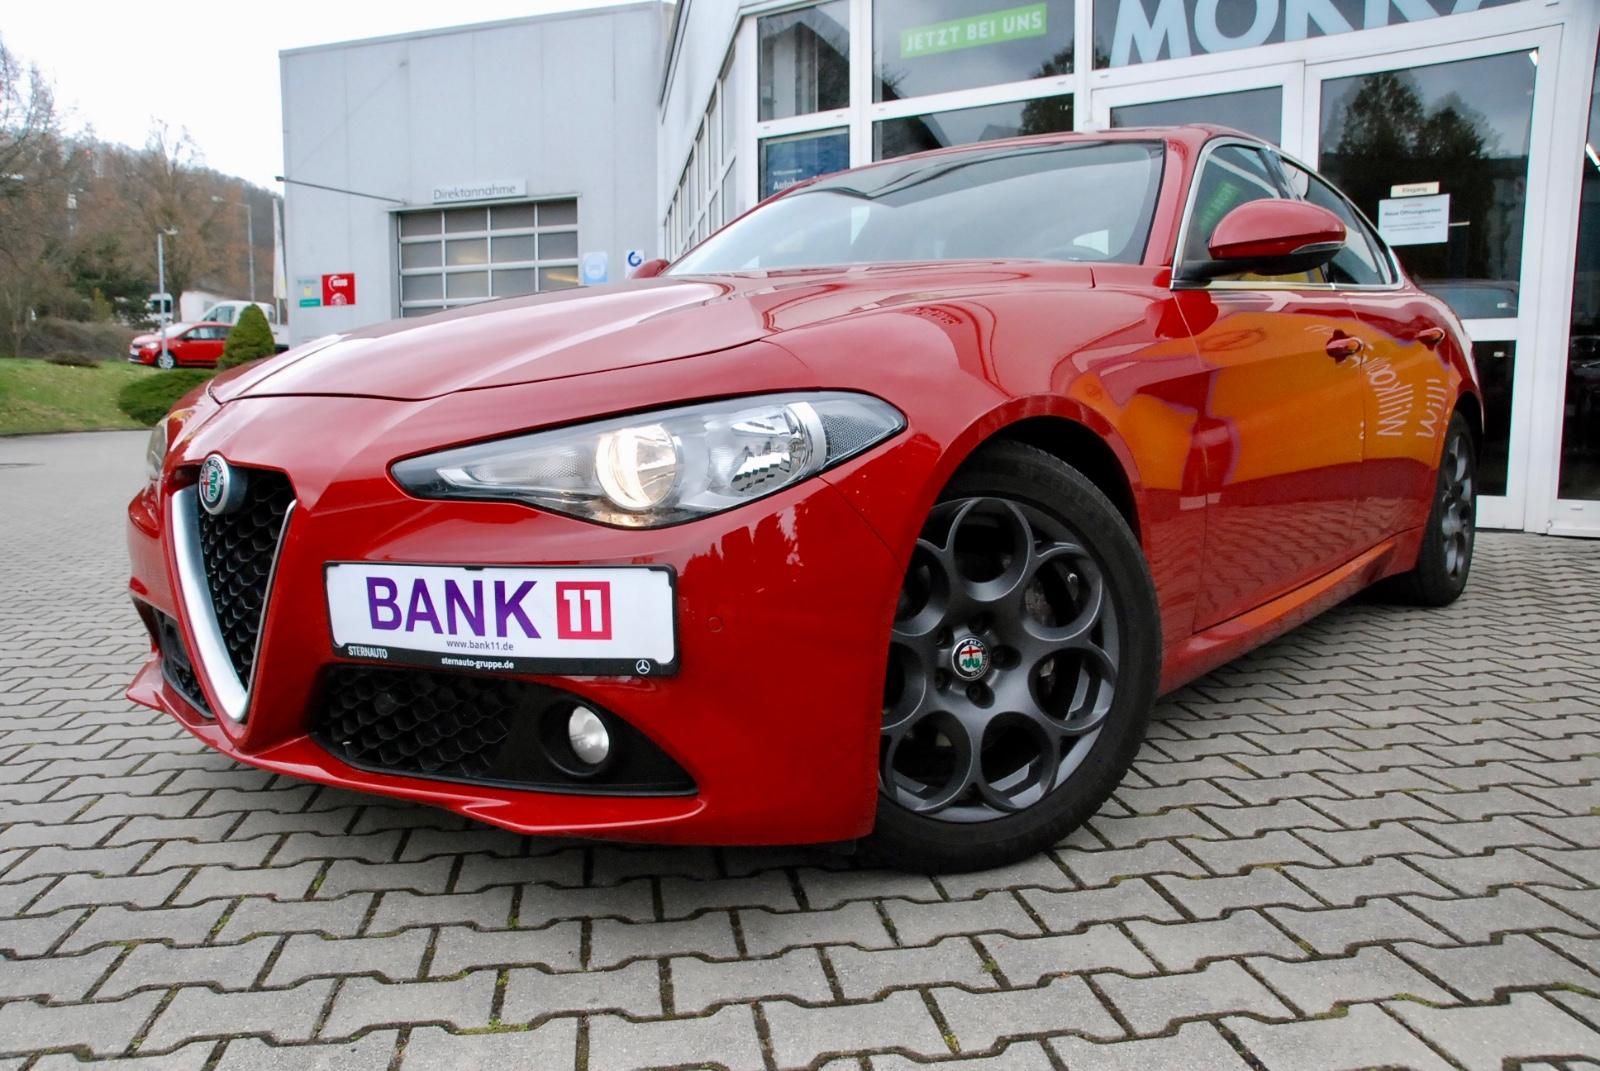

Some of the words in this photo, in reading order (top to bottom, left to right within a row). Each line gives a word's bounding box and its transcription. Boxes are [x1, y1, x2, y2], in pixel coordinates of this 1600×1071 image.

[905, 26, 960, 52] JETZT
[966, 20, 996, 41] BEI
[1002, 11, 1042, 34] UNS
[433, 183, 516, 200] Direktannahme
[365, 576, 542, 640] BANK
[562, 587, 604, 633] 11
[348, 645, 388, 660] STERNAUTO
[447, 639, 514, 651] www.bank11.de
[441, 656, 514, 670] sternauto-gruppe.de
